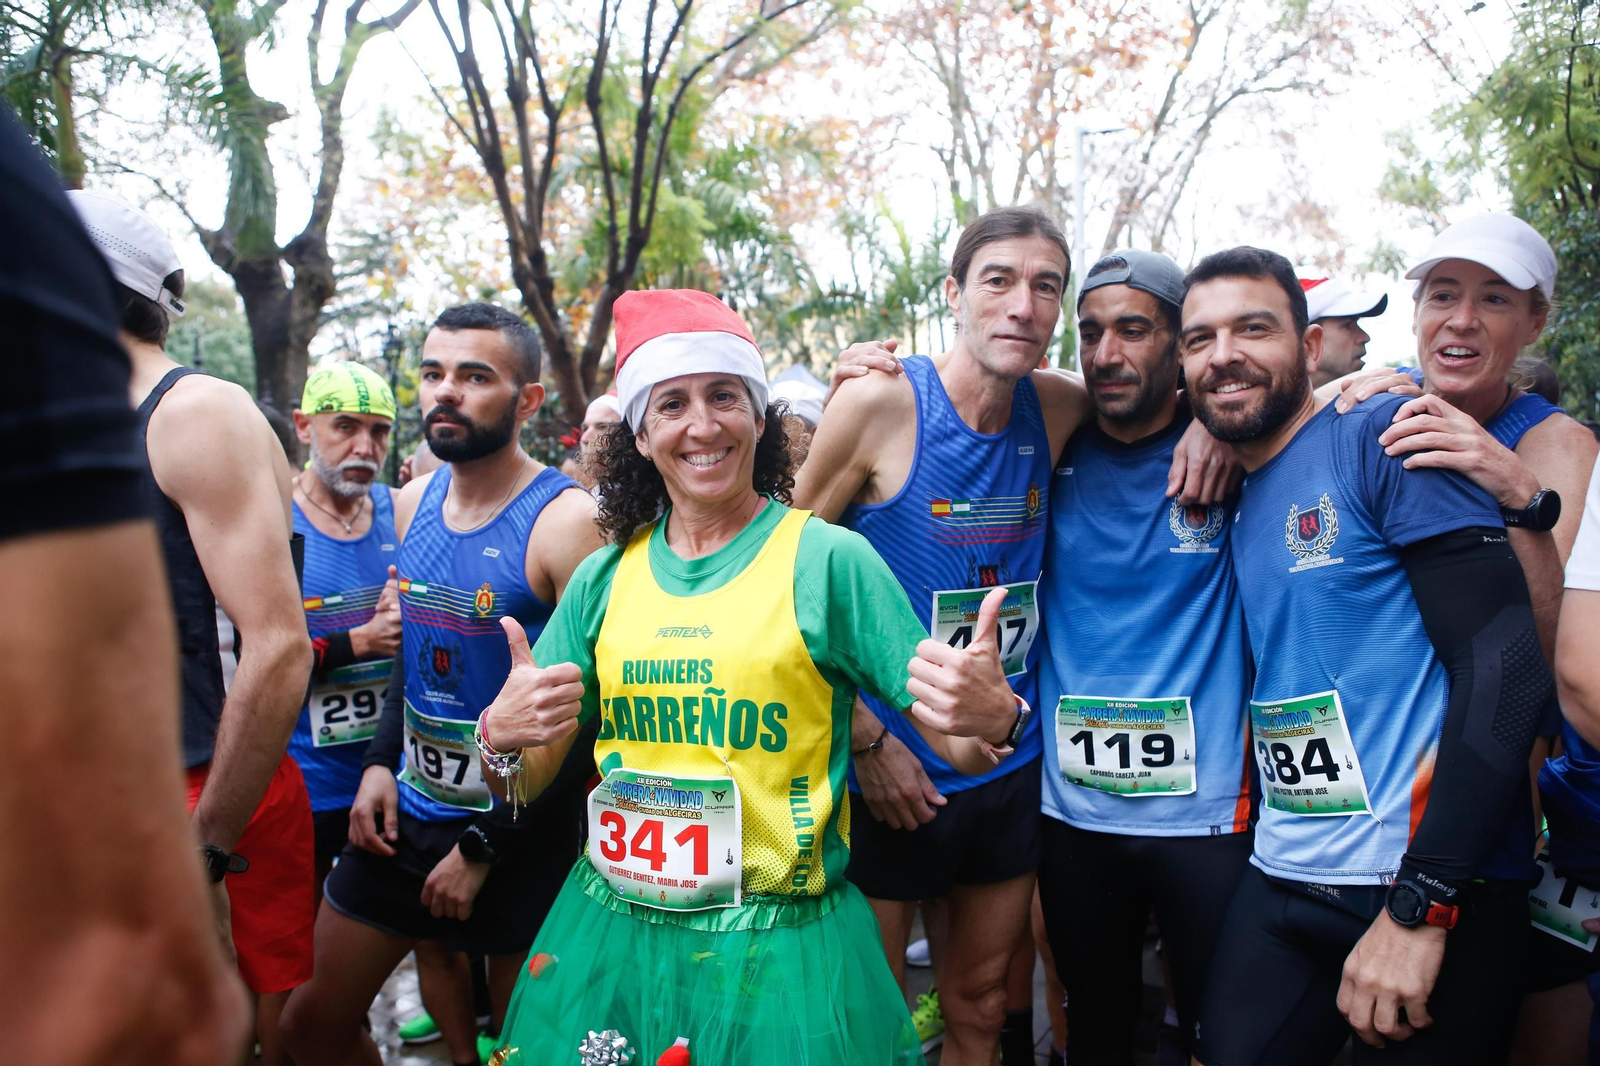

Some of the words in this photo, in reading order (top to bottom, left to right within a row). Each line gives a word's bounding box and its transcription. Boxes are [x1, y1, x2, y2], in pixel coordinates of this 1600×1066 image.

[655, 627, 699, 637] PENTEX
[947, 618, 1027, 655] 47
[622, 658, 713, 685] RUNNERS
[1079, 706, 1121, 722] CARRERA
[1122, 708, 1166, 723] NAVIDAD
[1273, 710, 1313, 730] NAVIDAD
[409, 736, 470, 786] 197
[1069, 730, 1175, 769] 119
[1257, 737, 1341, 785] 384
[645, 777, 673, 787] EDICIÓN
[1314, 787, 1329, 796] JOSE
[611, 780, 651, 805] CARRERA
[654, 787, 704, 811] NAVIDAD
[788, 775, 815, 830] VILLA
[664, 809, 703, 820] ALGECIRAS
[600, 810, 709, 876] 341
[796, 833, 815, 859] DE
[608, 864, 633, 880] GUTIERREZ
[633, 871, 656, 885] BENITEZ,
[657, 877, 679, 888] MARIA
[680, 880, 698, 889] JOSE
